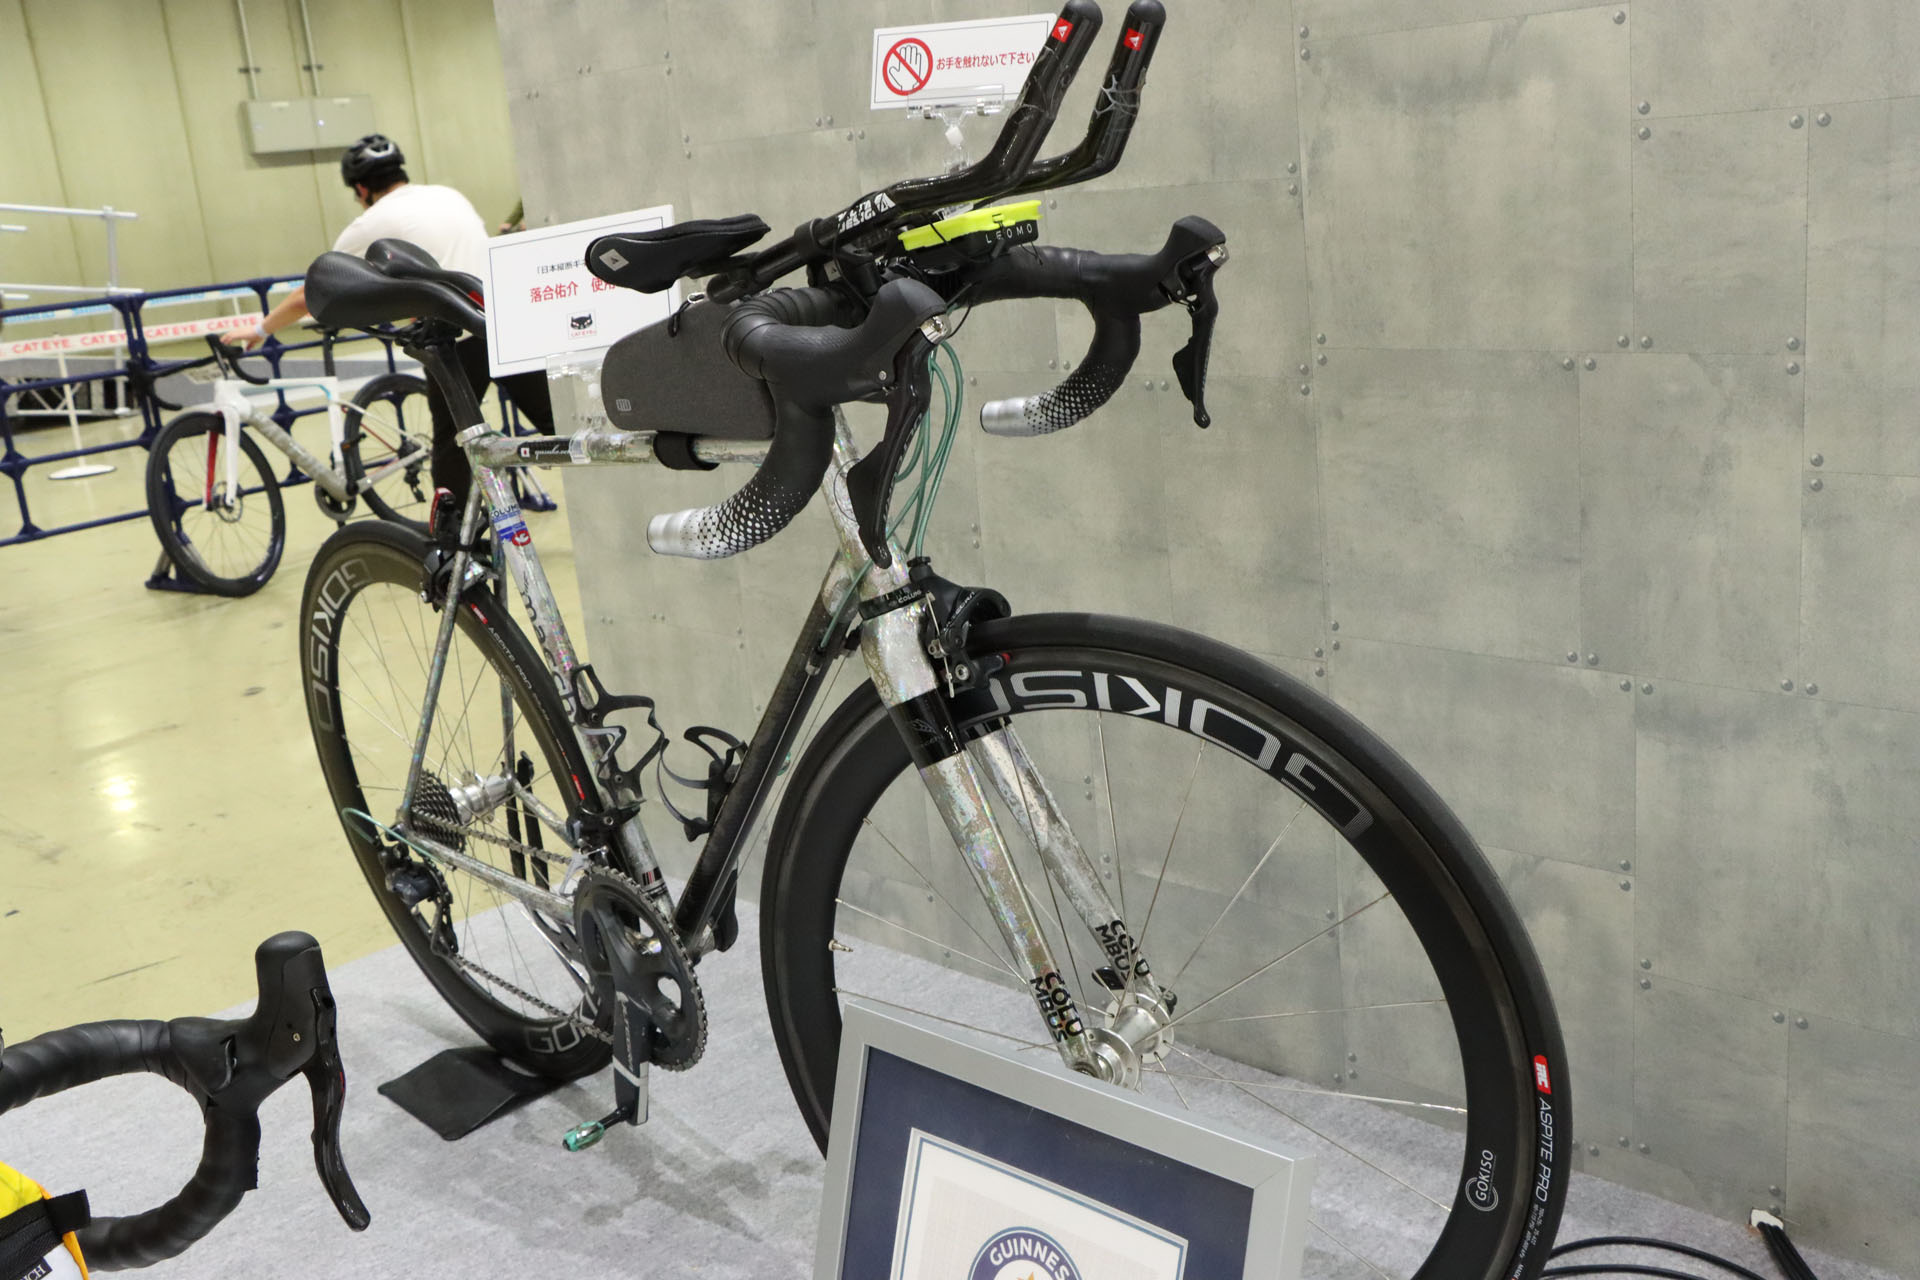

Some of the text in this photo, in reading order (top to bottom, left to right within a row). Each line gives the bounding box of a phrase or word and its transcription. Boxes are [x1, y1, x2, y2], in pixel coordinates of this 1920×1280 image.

[936, 52, 1035, 70] お手を触れないで下さい
[985, 223, 1033, 244] LEOMO
[530, 281, 579, 303] 落合佑介
[12, 339, 71, 354] CATEYE
[1538, 1097, 1553, 1162] ASPITE
[1475, 1150, 1494, 1201] GOKISO
[1534, 1163, 1551, 1202] PRO
[989, 1237, 1070, 1280] GUINNES
